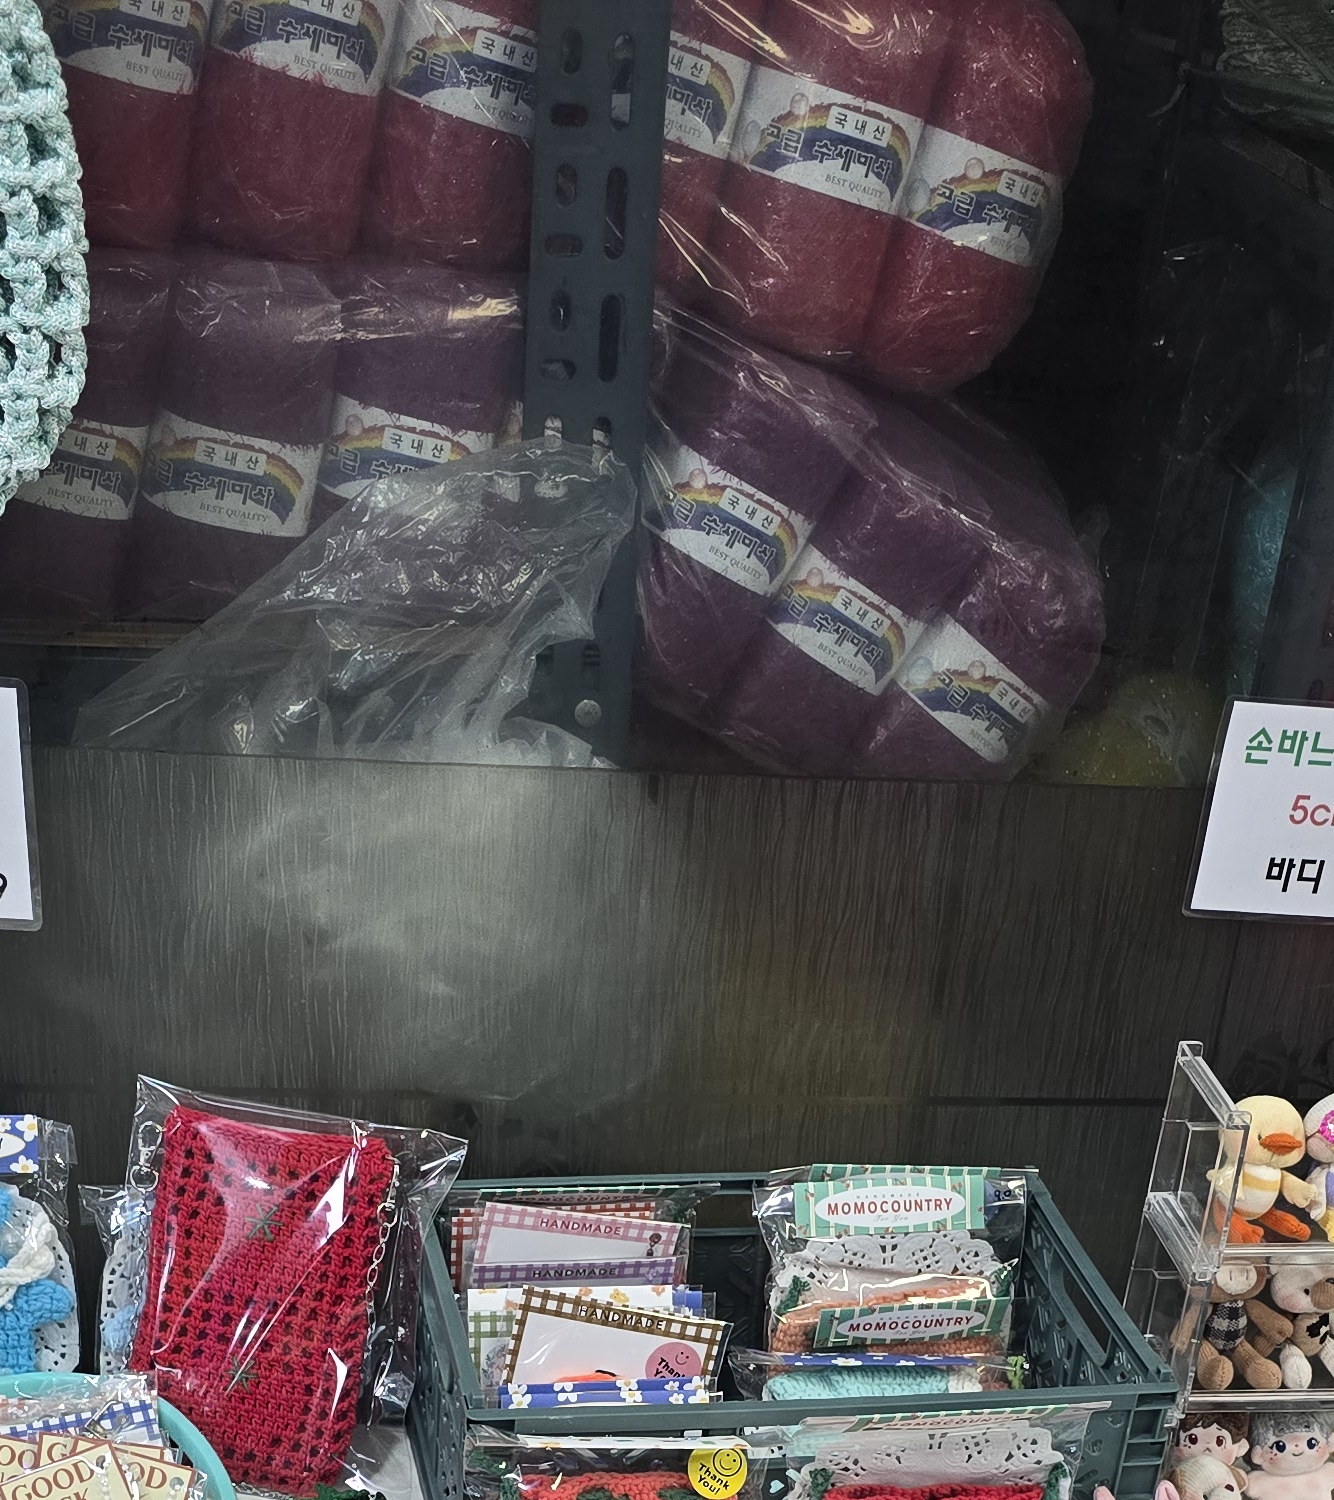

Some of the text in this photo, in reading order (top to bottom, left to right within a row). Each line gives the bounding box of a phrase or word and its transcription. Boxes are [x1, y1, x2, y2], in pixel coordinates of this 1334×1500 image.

[293, 54, 317, 70] BEST
[481, 36, 535, 67] 국내산
[126, 60, 150, 75] BEST
[834, 111, 886, 141] 국내산
[825, 173, 886, 199] BEST QUALITY
[202, 445, 261, 471] 국내산
[390, 433, 445, 459] 국내산
[47, 486, 72, 499] BEST
[199, 502, 269, 523] BEST QUALITY
[726, 494, 776, 531] 국내산
[708, 545, 764, 581] BEST QUALITY
[840, 594, 885, 631] 국내산
[817, 642, 870, 679] BEST QUALITY
[1265, 856, 1326, 894] 바디
[827, 1197, 953, 1217] MOMOCOUNTRY
[540, 1217, 622, 1236] HANDMADE
[532, 1267, 618, 1279] HANDMADE
[578, 1305, 664, 1331] HANDMADE
[848, 1315, 975, 1334] MOMOCOUNTRY
[657, 1357, 686, 1378] Than
[697, 1474, 722, 1496] You!
[698, 1462, 730, 1491] Thank
